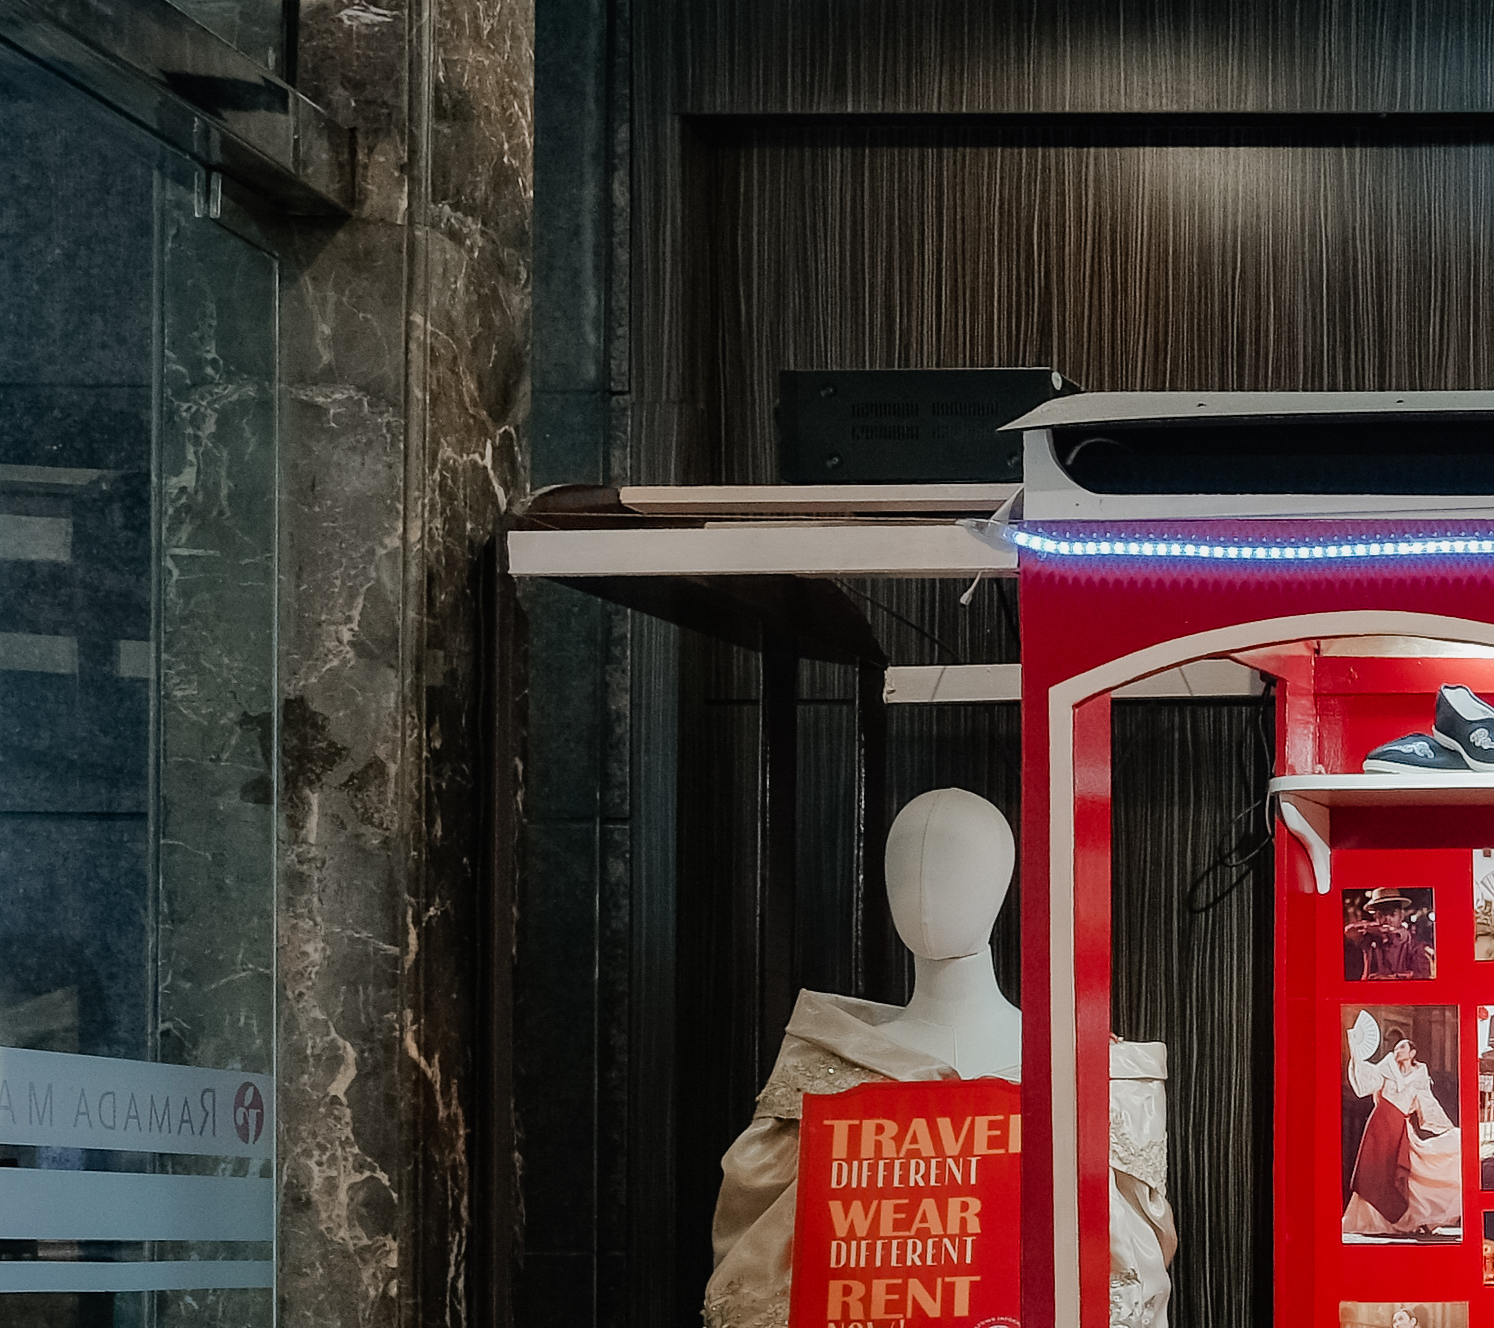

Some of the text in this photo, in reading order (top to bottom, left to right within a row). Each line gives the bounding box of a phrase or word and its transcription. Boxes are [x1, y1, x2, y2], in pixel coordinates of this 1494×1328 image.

[831, 1157, 982, 1189] DIFFERENT
[828, 1197, 982, 1238] WEAR
[829, 1236, 977, 1268] DIFFERENT
[826, 1276, 982, 1321] RENT
